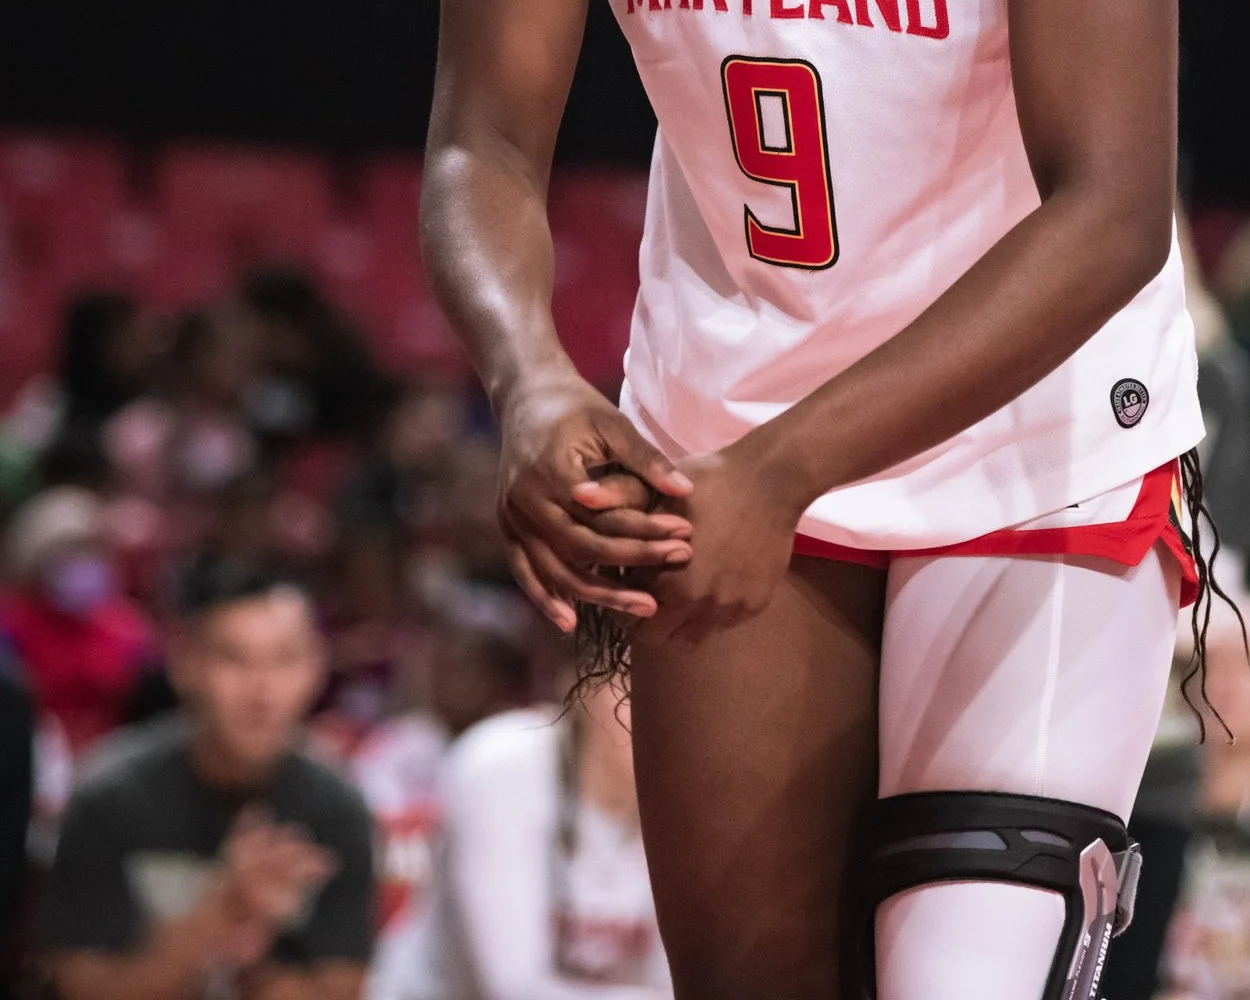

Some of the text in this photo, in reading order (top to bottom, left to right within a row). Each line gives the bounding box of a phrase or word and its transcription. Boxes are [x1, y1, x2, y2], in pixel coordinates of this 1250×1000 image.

[720, 55, 840, 271] 9
[1122, 393, 1139, 407] LG
[1089, 922, 1112, 998] TITANIUM
